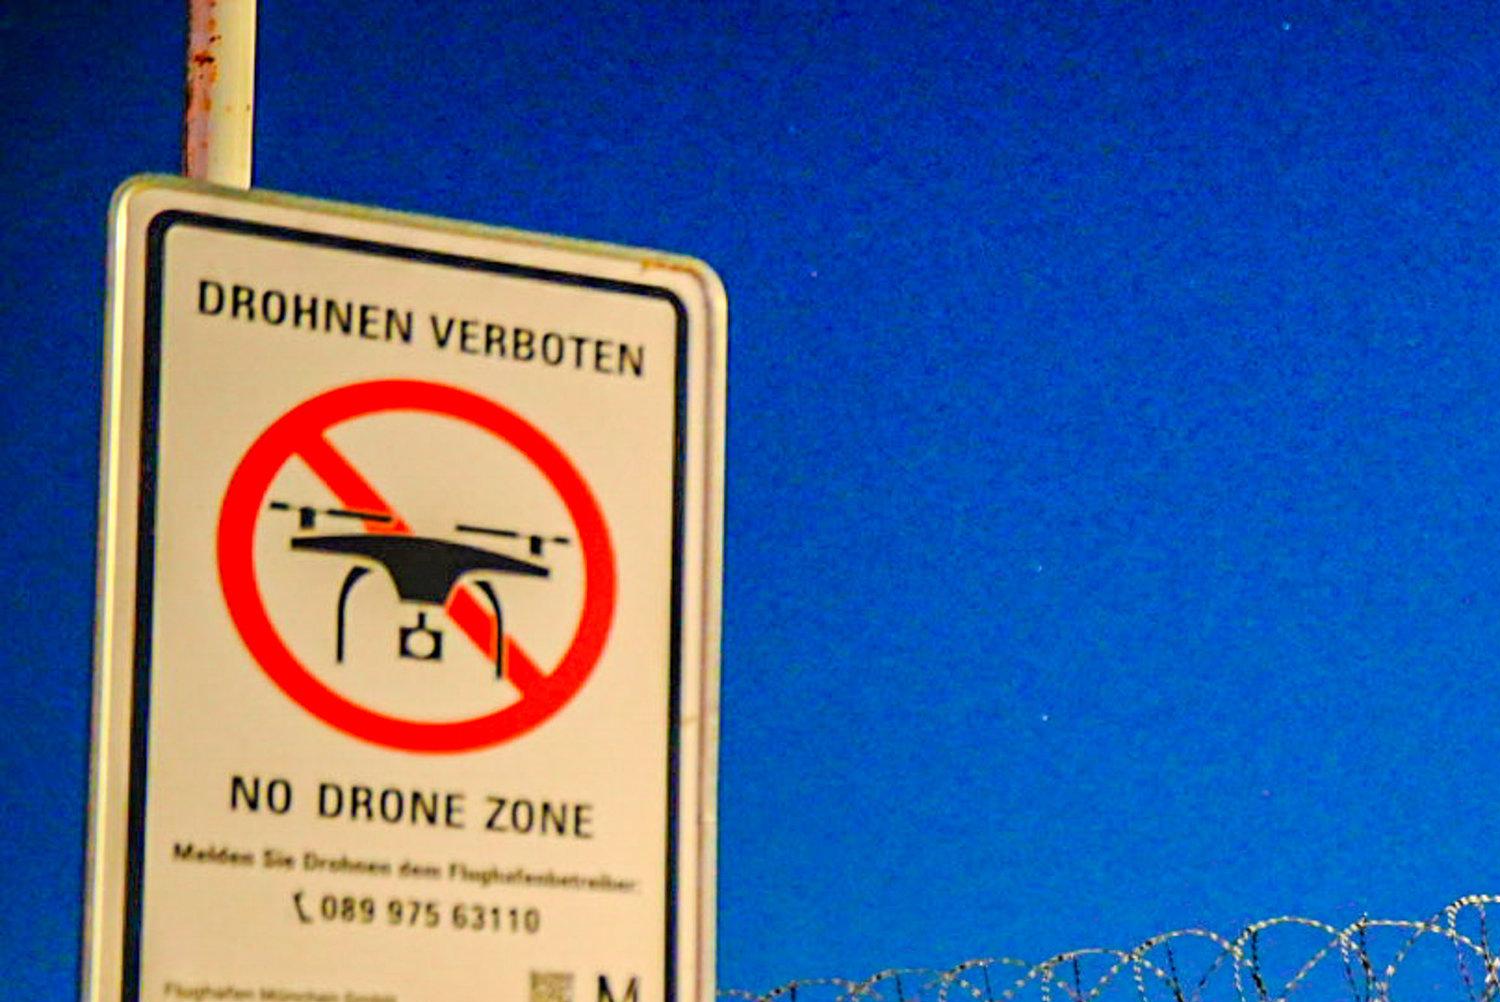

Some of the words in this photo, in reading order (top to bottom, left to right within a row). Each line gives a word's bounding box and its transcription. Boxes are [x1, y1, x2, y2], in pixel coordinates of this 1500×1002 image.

[196, 278, 414, 345] DROHNEN
[430, 312, 646, 378] VERBOTEN
[229, 775, 293, 815] NO
[317, 782, 468, 829] DRONE
[485, 796, 595, 839] ZONE
[172, 842, 255, 866] Melden
[263, 848, 295, 869] Sie
[303, 851, 391, 875] Drohnen
[399, 859, 440, 879] dem
[320, 894, 376, 925] 089
[388, 899, 440, 929] 975
[451, 902, 542, 934] 63110
